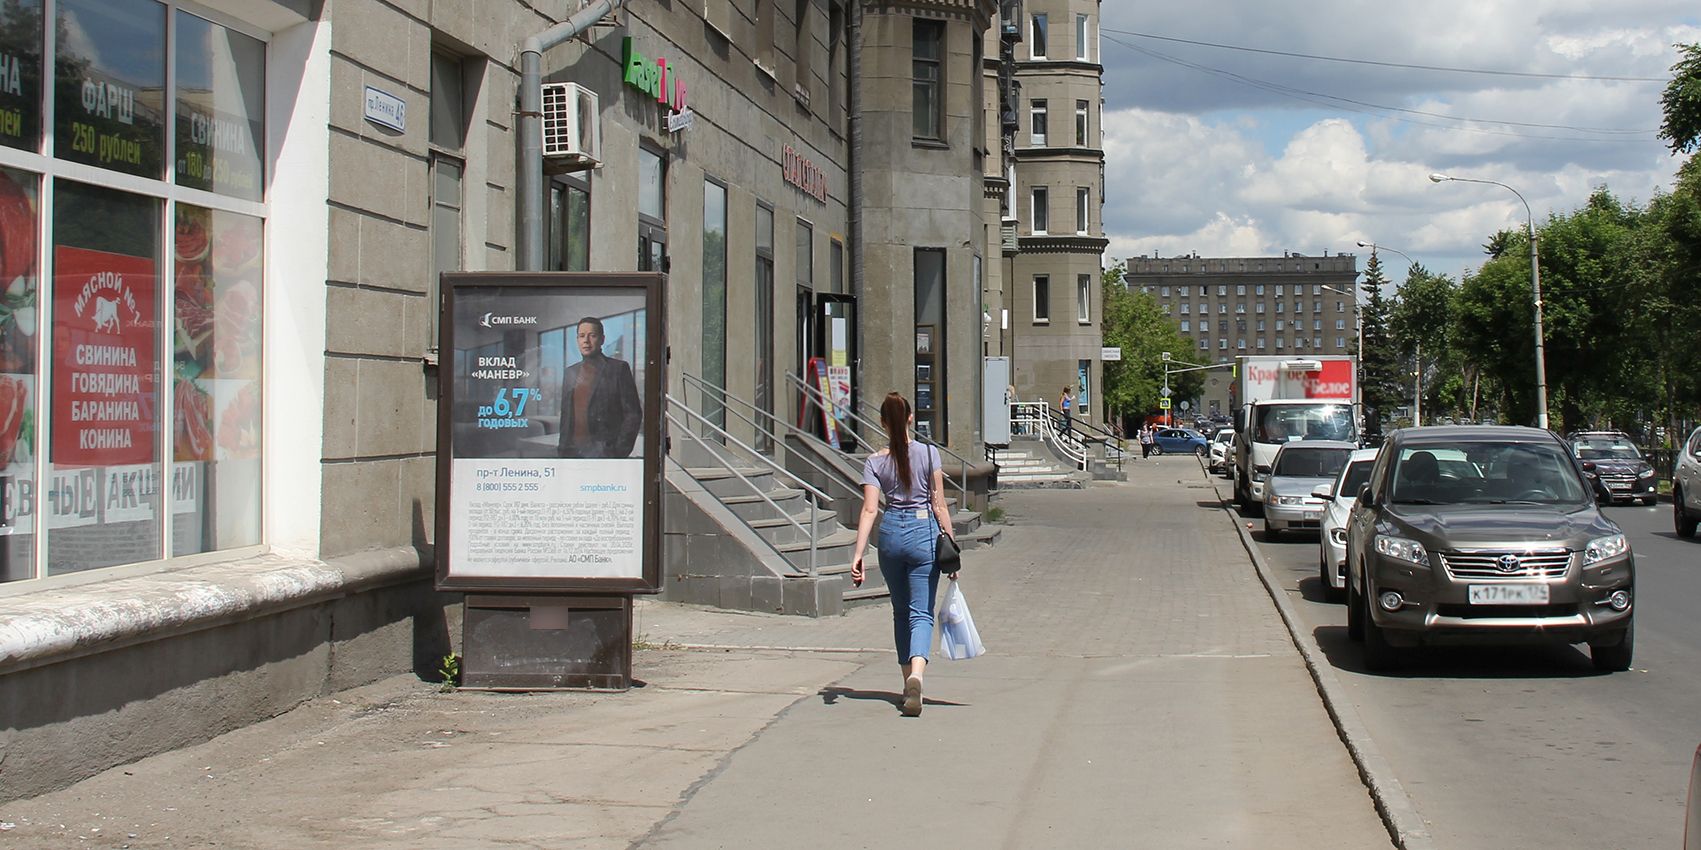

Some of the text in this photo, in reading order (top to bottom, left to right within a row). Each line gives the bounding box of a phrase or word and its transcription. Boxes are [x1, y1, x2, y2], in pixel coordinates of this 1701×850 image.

[81, 77, 133, 125] ФАРШ
[72, 122, 141, 165] 250 рублей
[191, 112, 245, 155] СВИНИНА
[187, 151, 203, 178] 180
[74, 271, 122, 318] МЯСНОЙ
[491, 316, 538, 325] СМП БАНК
[76, 344, 137, 367] СВИНИНА
[478, 357, 517, 369] ВКЛАД
[71, 372, 140, 397] ГОВЯДИНА
[471, 369, 530, 380] «МАНЕВР»
[1248, 365, 1303, 385] Красое
[1311, 378, 1350, 395] Белое
[72, 400, 140, 422] БАРАНИНА
[79, 428, 132, 450] КОНИНА
[476, 467, 556, 479] пр-т Ленина, 51
[476, 483, 482, 491] 8
[502, 483, 518, 491] 555
[518, 483, 524, 491] 2
[524, 483, 539, 491] 555
[580, 484, 627, 493] smpbank.ru
